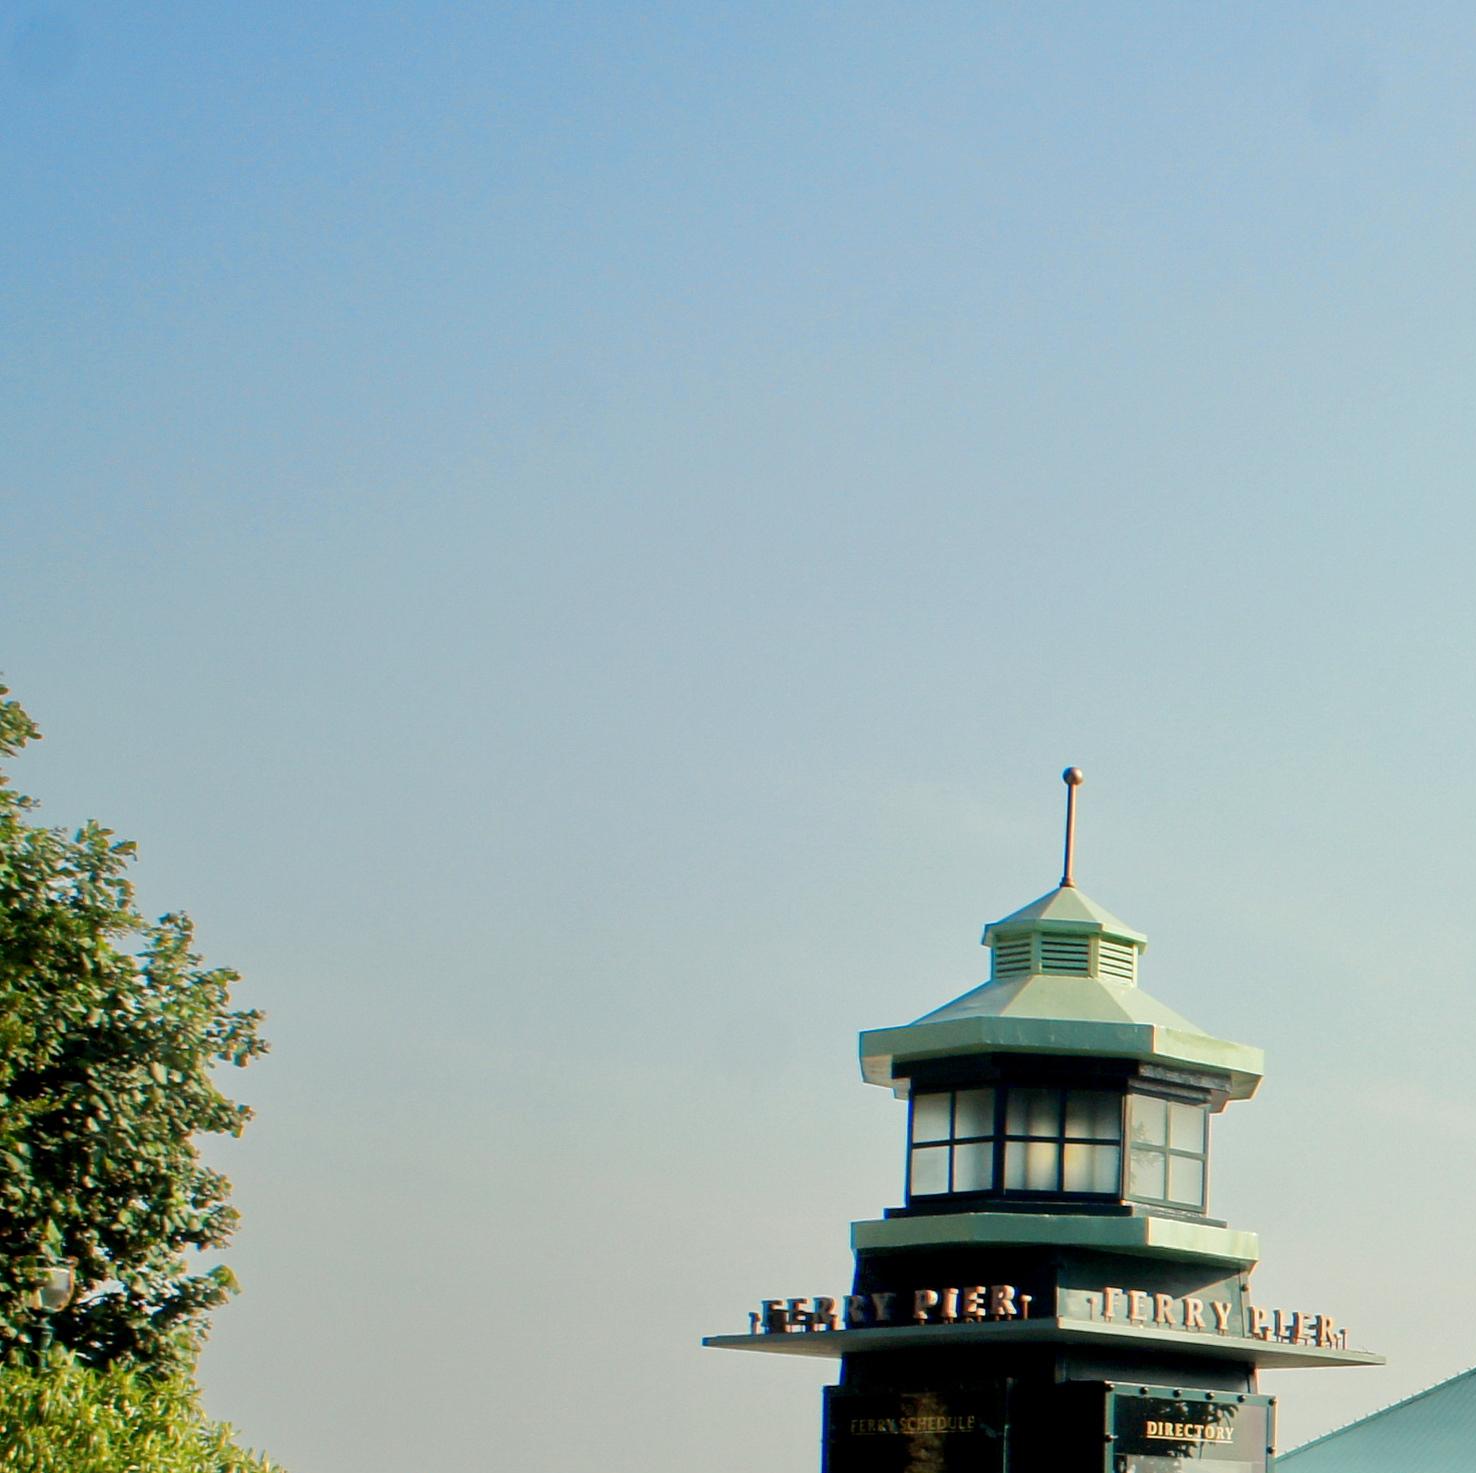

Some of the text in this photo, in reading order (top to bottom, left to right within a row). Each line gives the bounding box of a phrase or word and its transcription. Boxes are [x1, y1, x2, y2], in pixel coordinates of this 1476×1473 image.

[763, 1285, 1016, 1331] FERRY PIER
[1102, 1286, 1341, 1346] FERRY PIER
[850, 1415, 975, 1433] FERRY SCHEDULE
[1146, 1420, 1234, 1440] DIRECTORY
